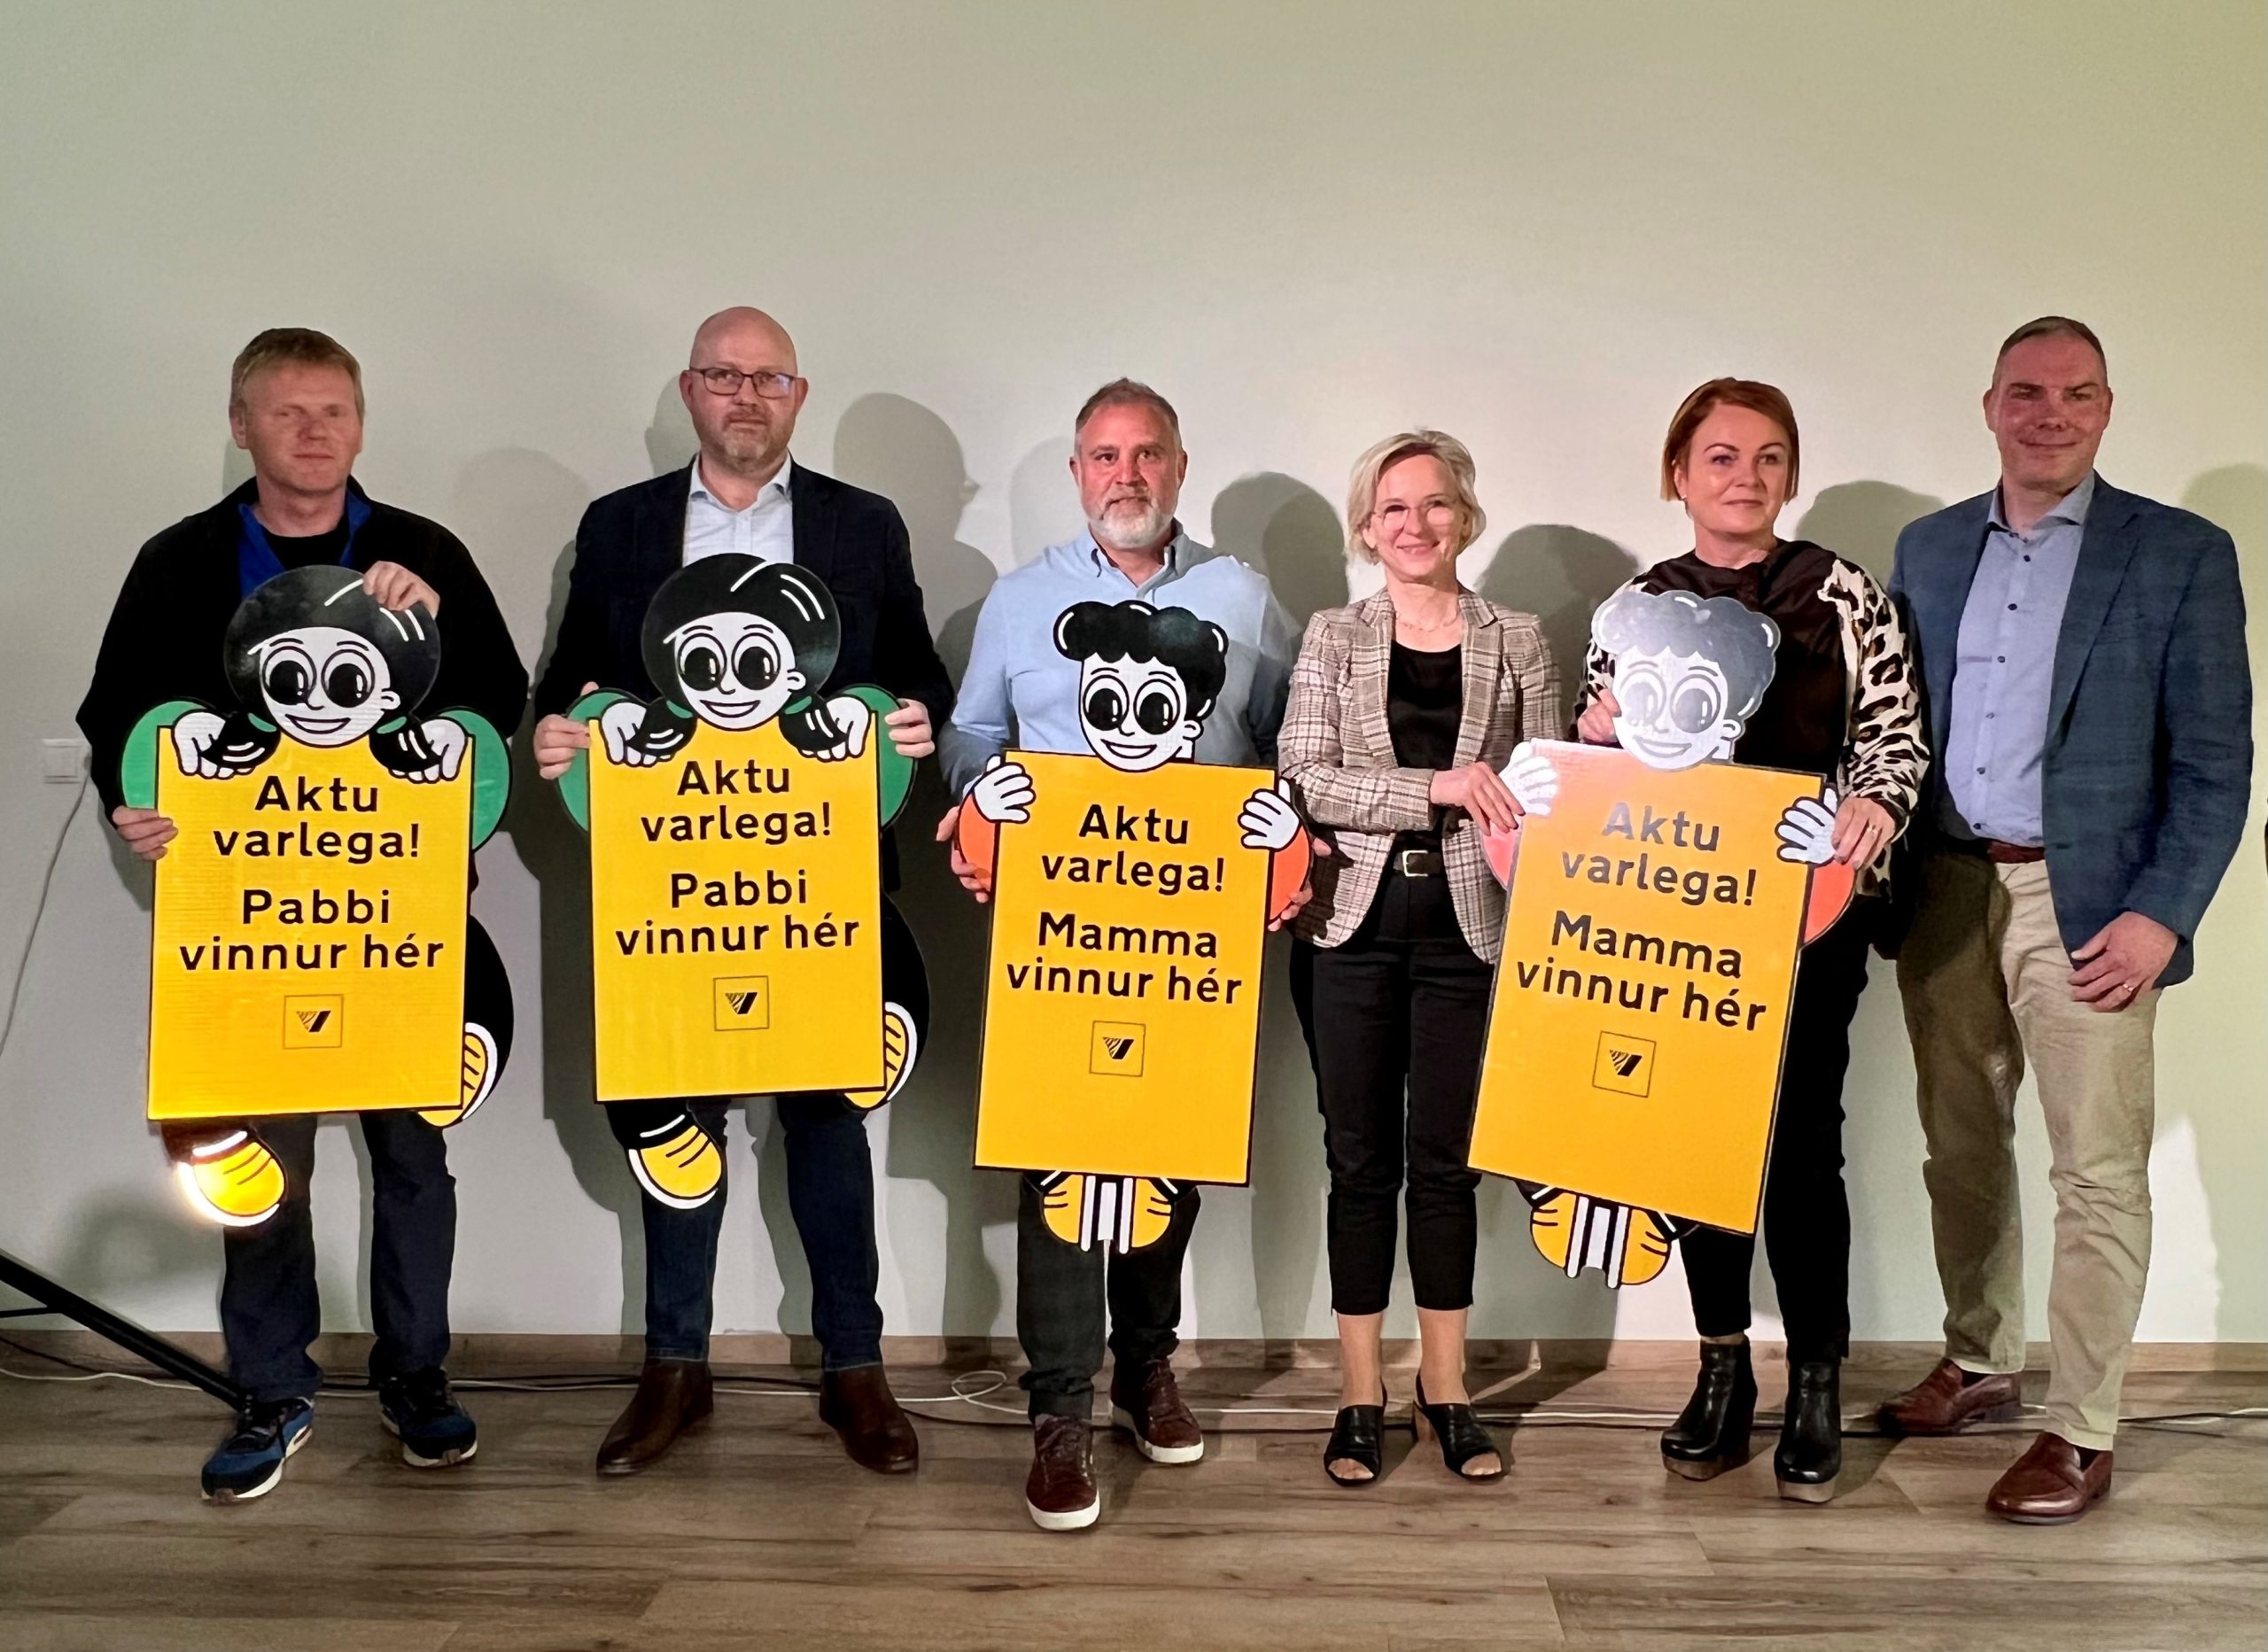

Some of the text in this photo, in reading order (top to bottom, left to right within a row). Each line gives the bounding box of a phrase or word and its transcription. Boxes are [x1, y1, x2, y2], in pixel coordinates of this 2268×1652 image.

[254, 775, 378, 812] Aktu
[677, 759, 790, 795] Aktu
[213, 821, 419, 864] varlega!
[641, 802, 830, 845] varlega!
[1078, 803, 1189, 845] Aktu
[1601, 802, 1720, 852] Aktu
[671, 869, 806, 908] Pabbi
[1041, 850, 1224, 896] varlega!
[1561, 851, 1757, 906] varlega!
[243, 888, 390, 925] Pabbi
[179, 933, 444, 971] vinnur hér
[616, 912, 859, 956] vinnur hér
[1038, 911, 1217, 959] Mamma
[1551, 910, 1743, 980] Mamma
[1006, 956, 1242, 1004] vinnur hér
[1517, 956, 1767, 1032] vinnur hér
